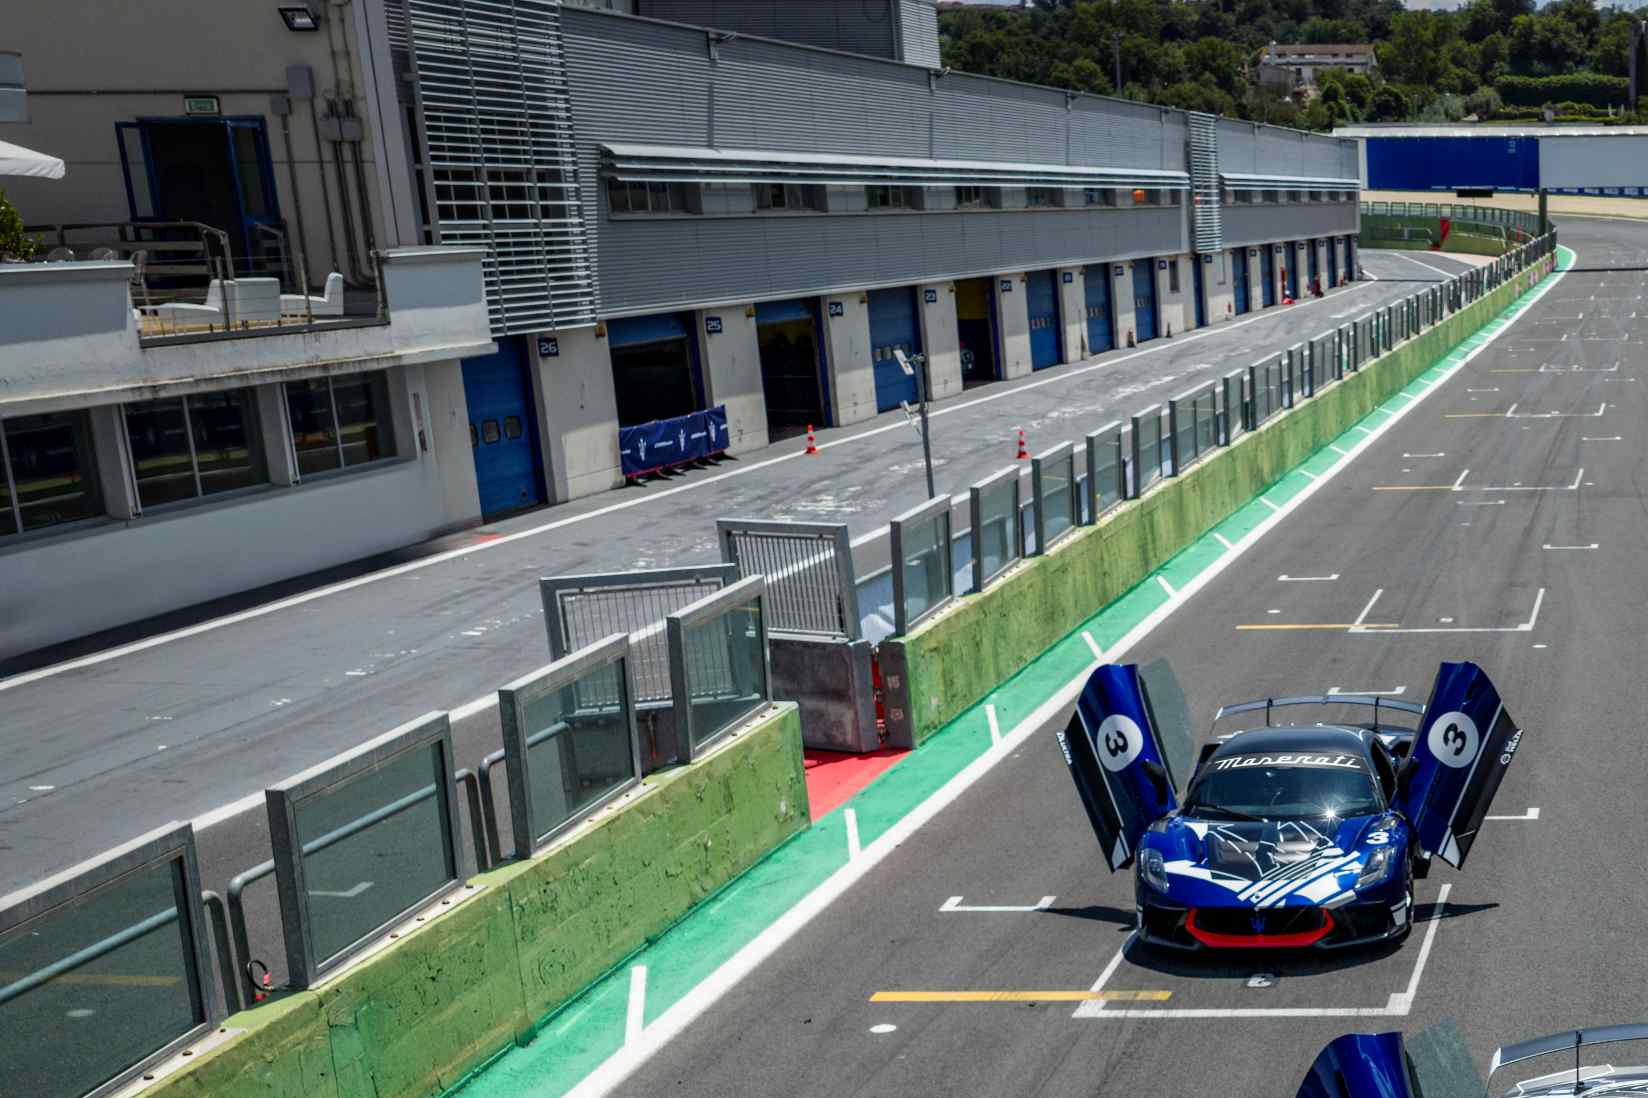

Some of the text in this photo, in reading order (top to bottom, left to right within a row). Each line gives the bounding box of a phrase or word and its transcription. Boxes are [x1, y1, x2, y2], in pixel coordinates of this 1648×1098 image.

[925, 291, 936, 300] 23
[830, 304, 842, 315] 24
[707, 319, 721, 331] 25
[540, 341, 557, 354] 26
[1105, 730, 1129, 757] 3
[1443, 722, 1467, 756] 3
[1215, 754, 1361, 770] Maserati
[1366, 831, 1390, 844] 3
